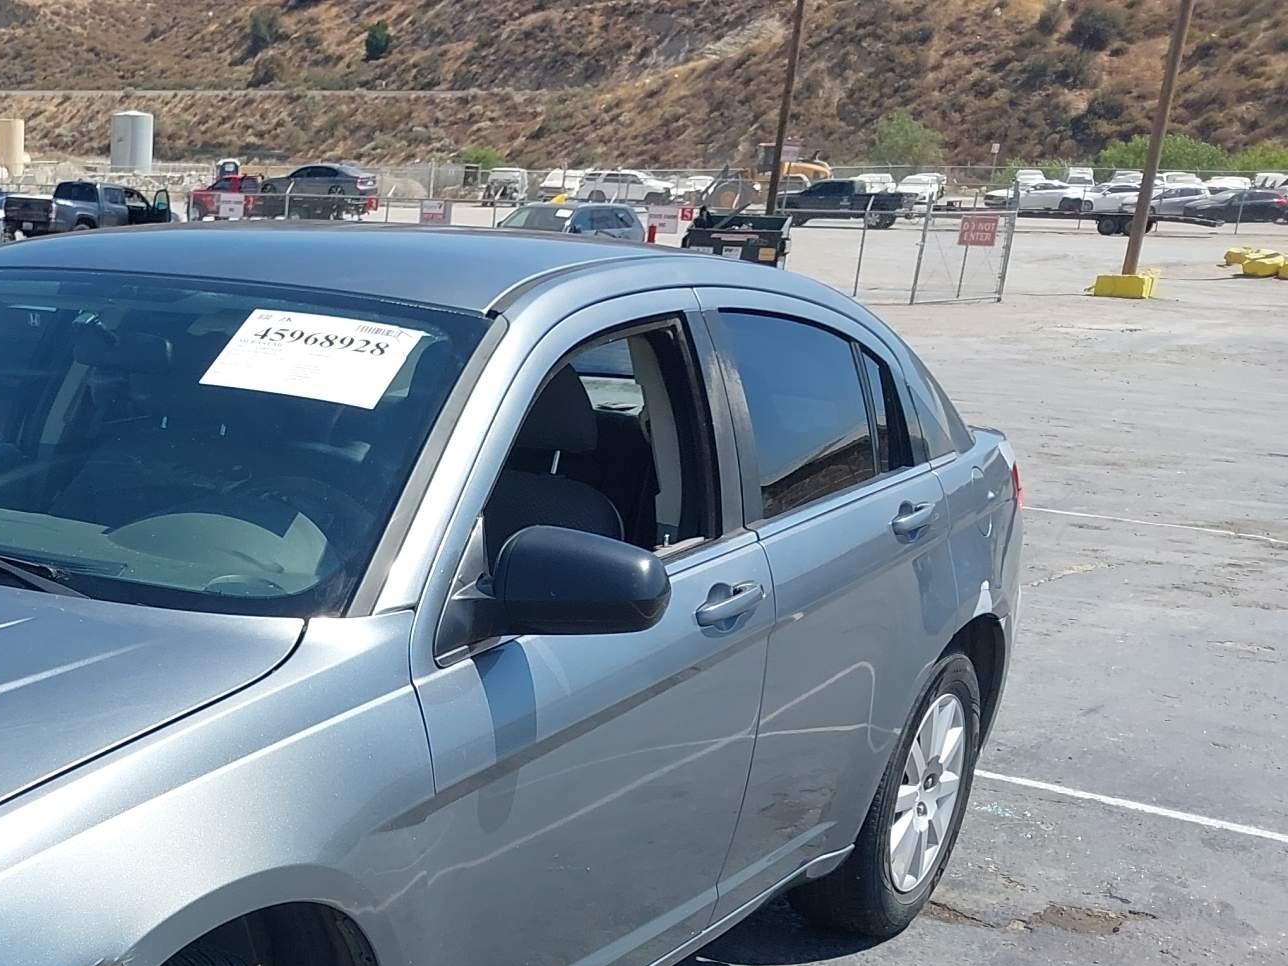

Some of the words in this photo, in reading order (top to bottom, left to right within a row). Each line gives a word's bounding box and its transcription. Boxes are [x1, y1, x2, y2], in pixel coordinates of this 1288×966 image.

[978, 222, 997, 232] NOT
[963, 231, 992, 241] ENTER
[253, 327, 390, 357] 45968928
